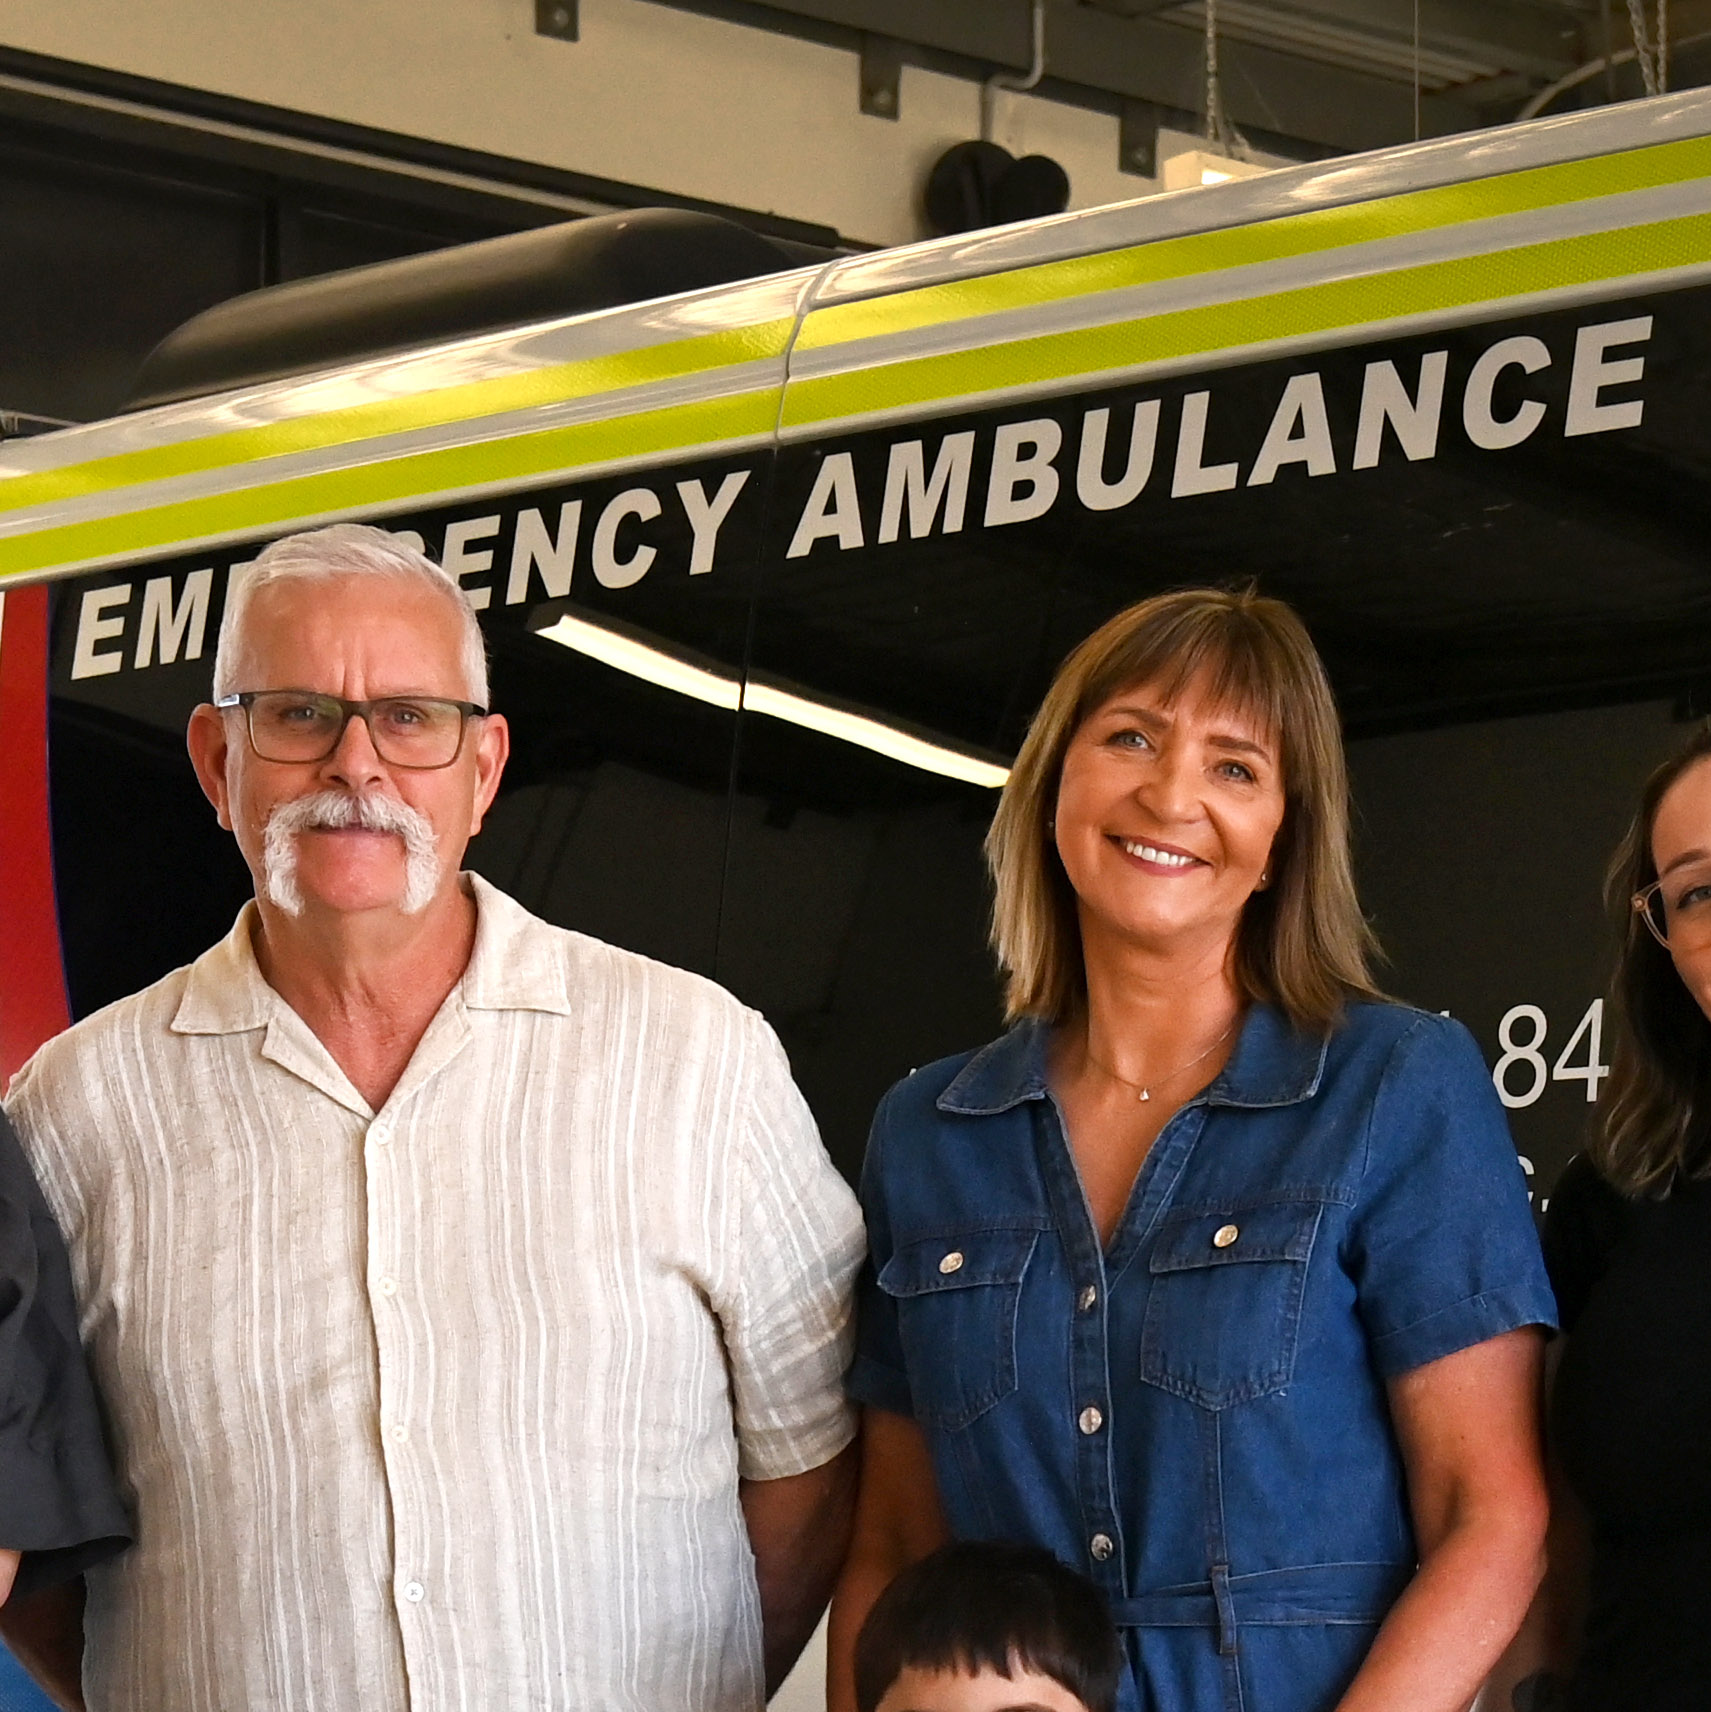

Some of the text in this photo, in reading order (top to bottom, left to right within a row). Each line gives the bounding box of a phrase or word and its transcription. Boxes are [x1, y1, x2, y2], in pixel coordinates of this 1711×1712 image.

[71, 316, 1654, 680] EMENCY AMBULANCE
[1492, 998, 1610, 1109] 84
